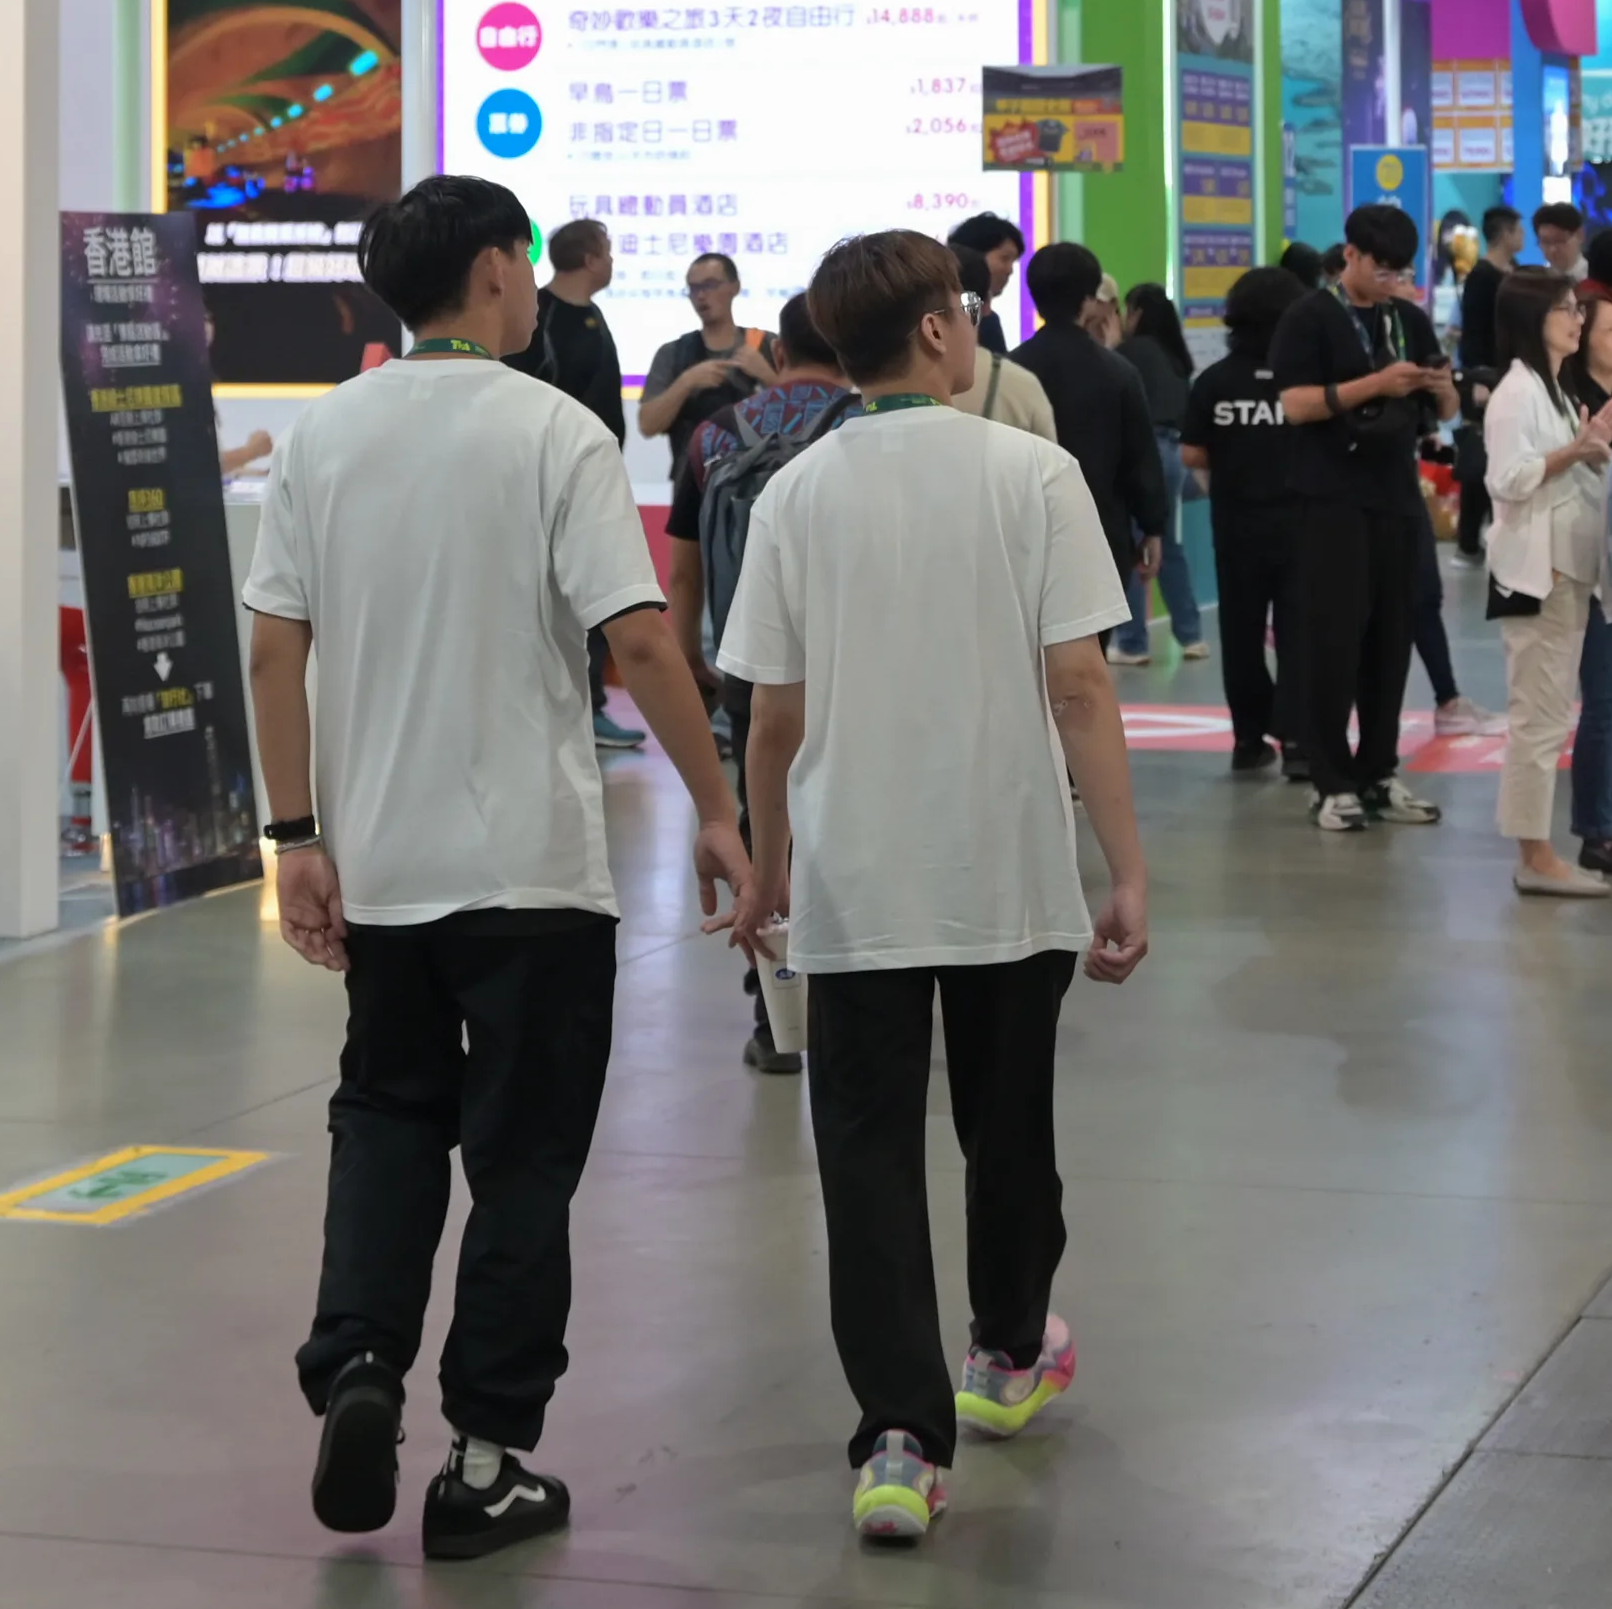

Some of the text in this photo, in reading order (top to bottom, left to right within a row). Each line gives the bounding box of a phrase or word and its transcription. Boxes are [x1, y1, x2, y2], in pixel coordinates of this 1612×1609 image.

[83, 226, 158, 277] 香港館
[610, 232, 789, 257] 迪士尼樂園酒店
